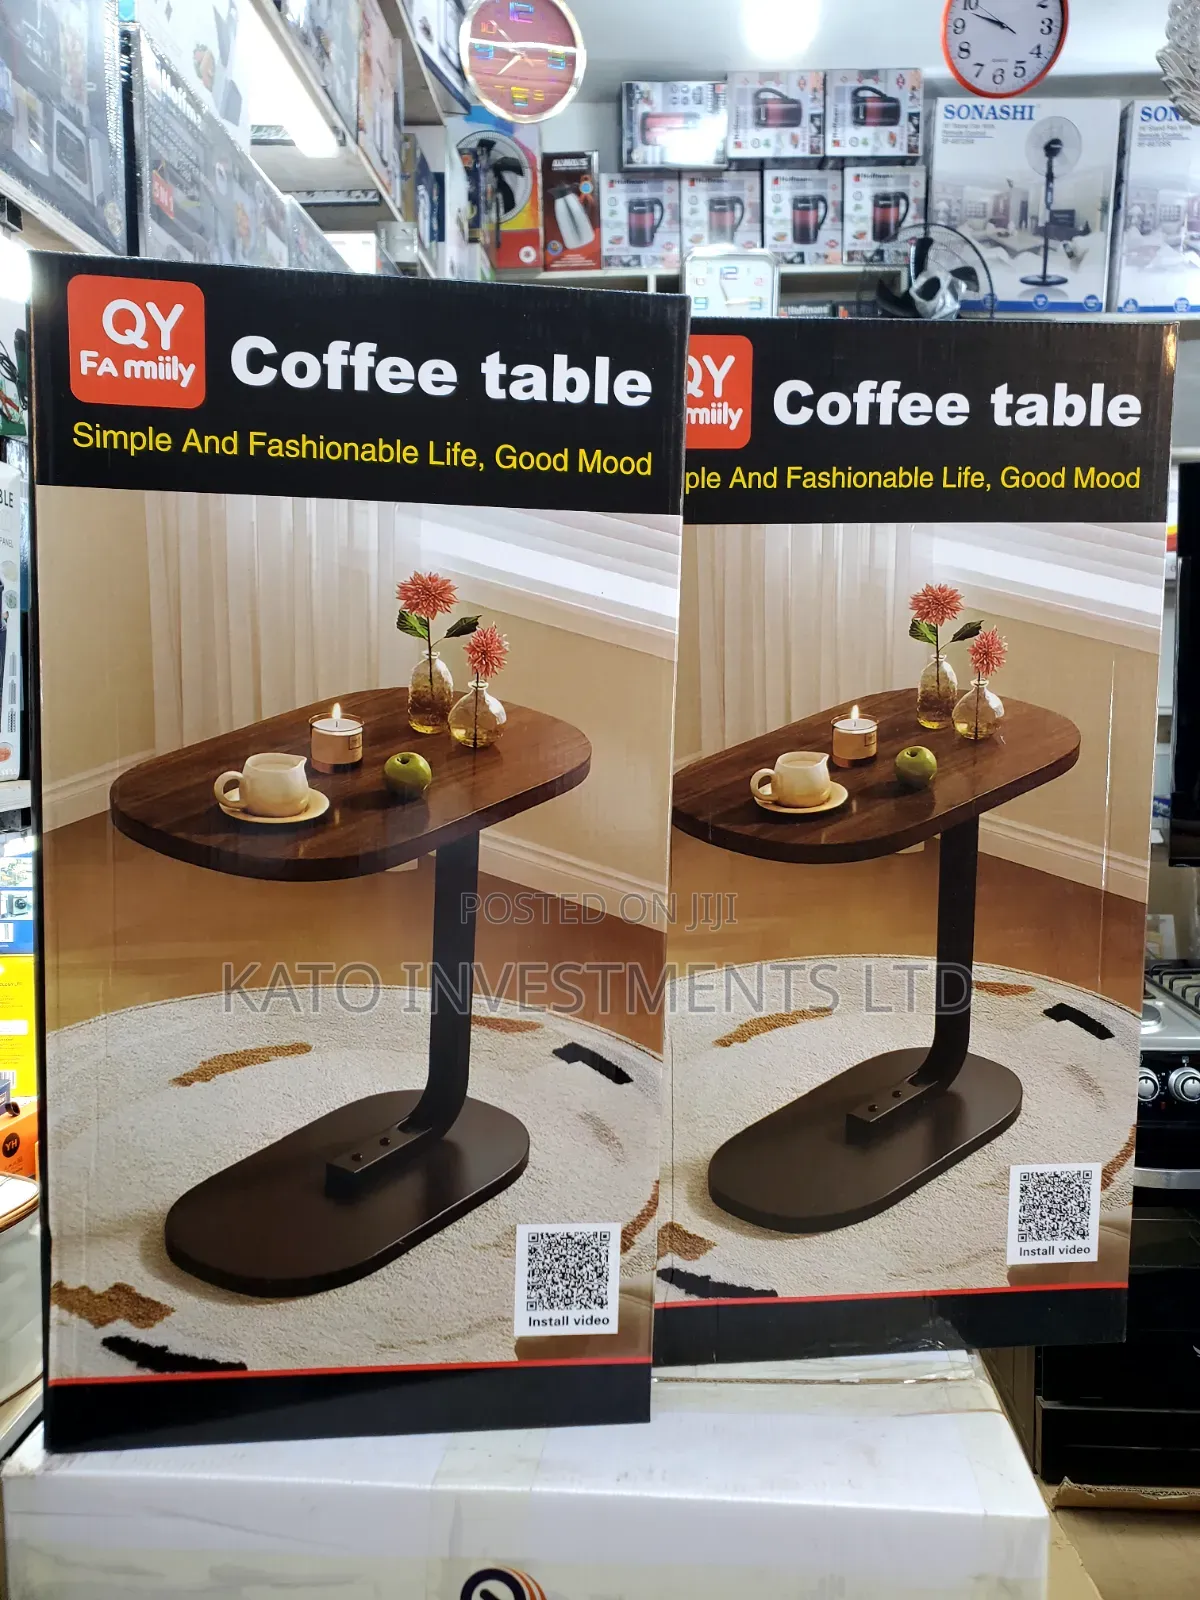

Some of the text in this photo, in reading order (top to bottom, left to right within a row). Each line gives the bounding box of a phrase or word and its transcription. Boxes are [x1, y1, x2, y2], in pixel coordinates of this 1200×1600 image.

[952, 17, 966, 35] 9
[1040, 17, 1053, 36] 3
[957, 41, 971, 60] 8
[1029, 43, 1041, 59] 4
[973, 62, 985, 79] 7
[992, 67, 1005, 85] 6
[1013, 60, 1026, 78] 5
[943, 104, 1035, 121] SONASHI
[720, 266, 739, 280] 12
[694, 296, 709, 310] 9
[102, 299, 185, 351] QY
[230, 335, 652, 407] Coffee table
[773, 379, 1142, 428] Coffee table
[72, 421, 652, 476] Simple And Fashionable Life, Good Mood
[685, 465, 1141, 495] ple And Fashionable Life, Good Mood
[5, 1138, 18, 1151] YH
[1019, 1244, 1091, 1257] Install video
[528, 1314, 610, 1328] Install video
